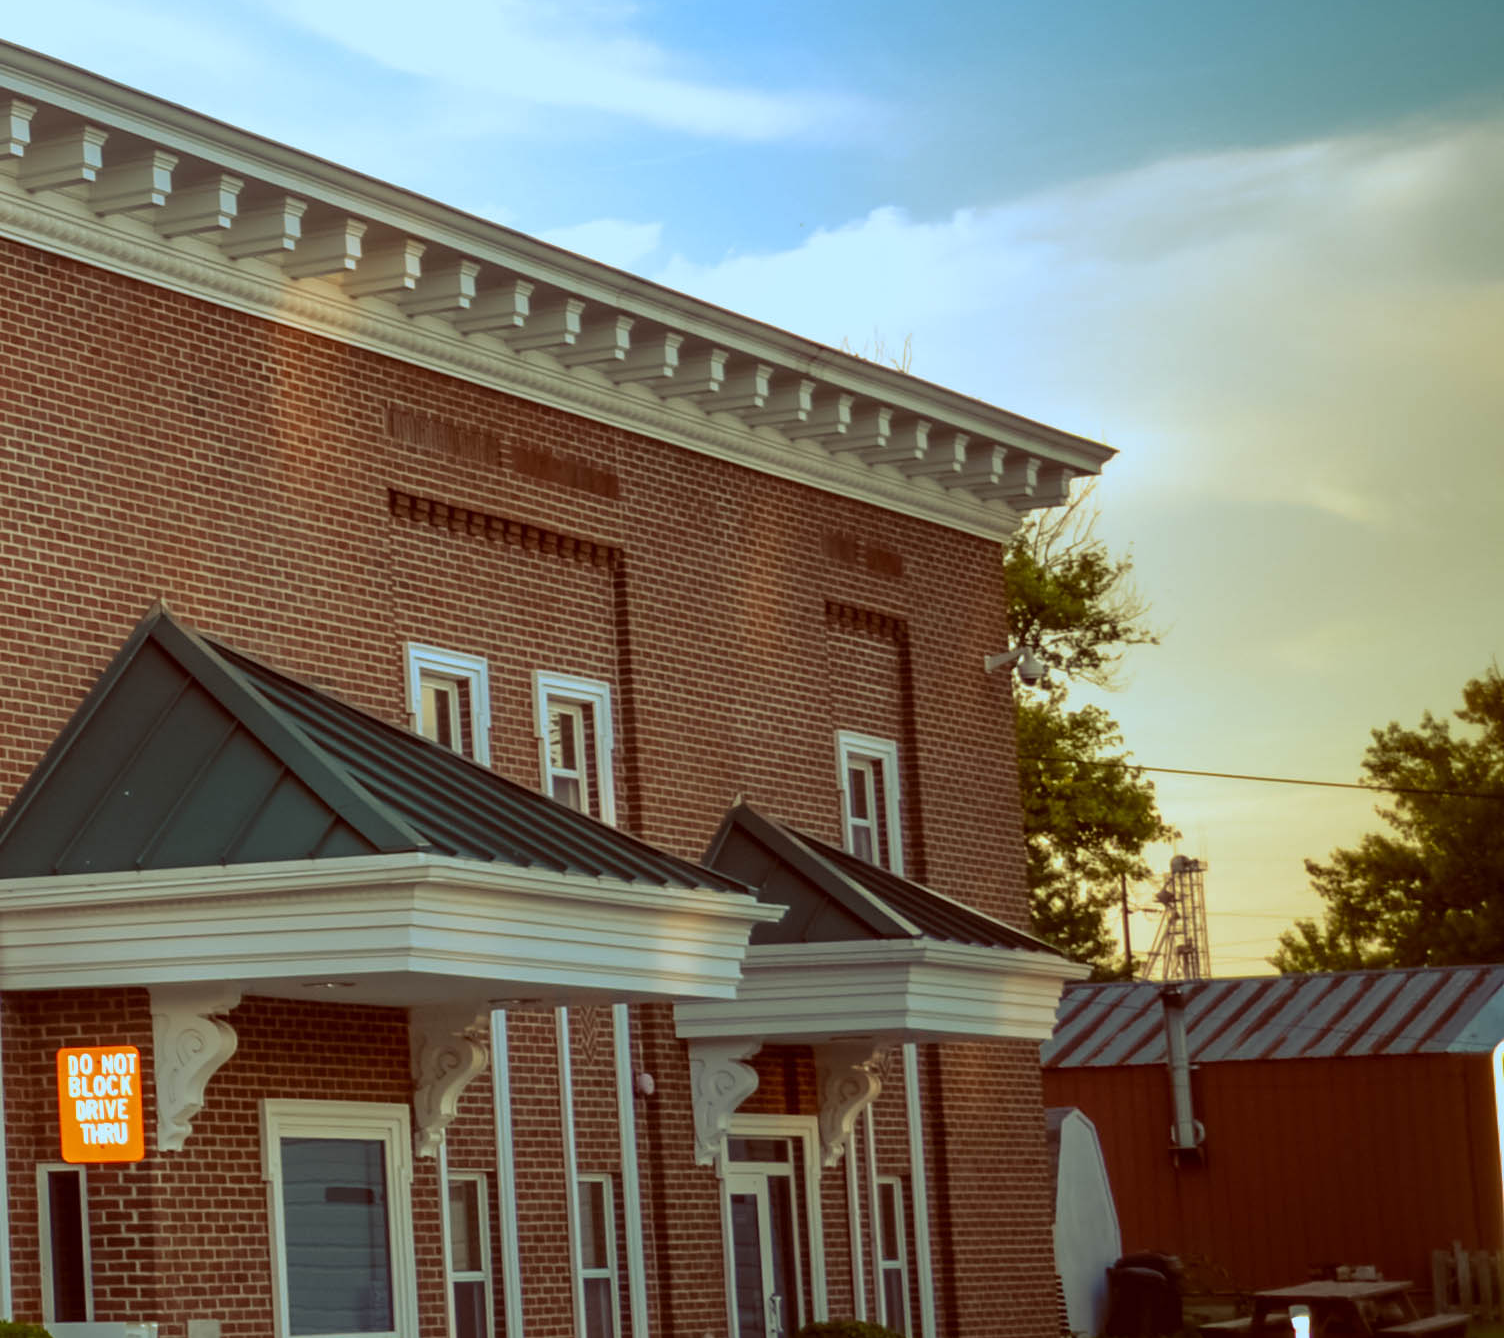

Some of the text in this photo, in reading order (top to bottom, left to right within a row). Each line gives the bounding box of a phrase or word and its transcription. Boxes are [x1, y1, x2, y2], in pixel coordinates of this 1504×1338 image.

[68, 1053, 137, 1076] DO NOT
[68, 1075, 133, 1098] BLOCK
[75, 1098, 129, 1122] DRIVE
[80, 1122, 128, 1145] THRU
